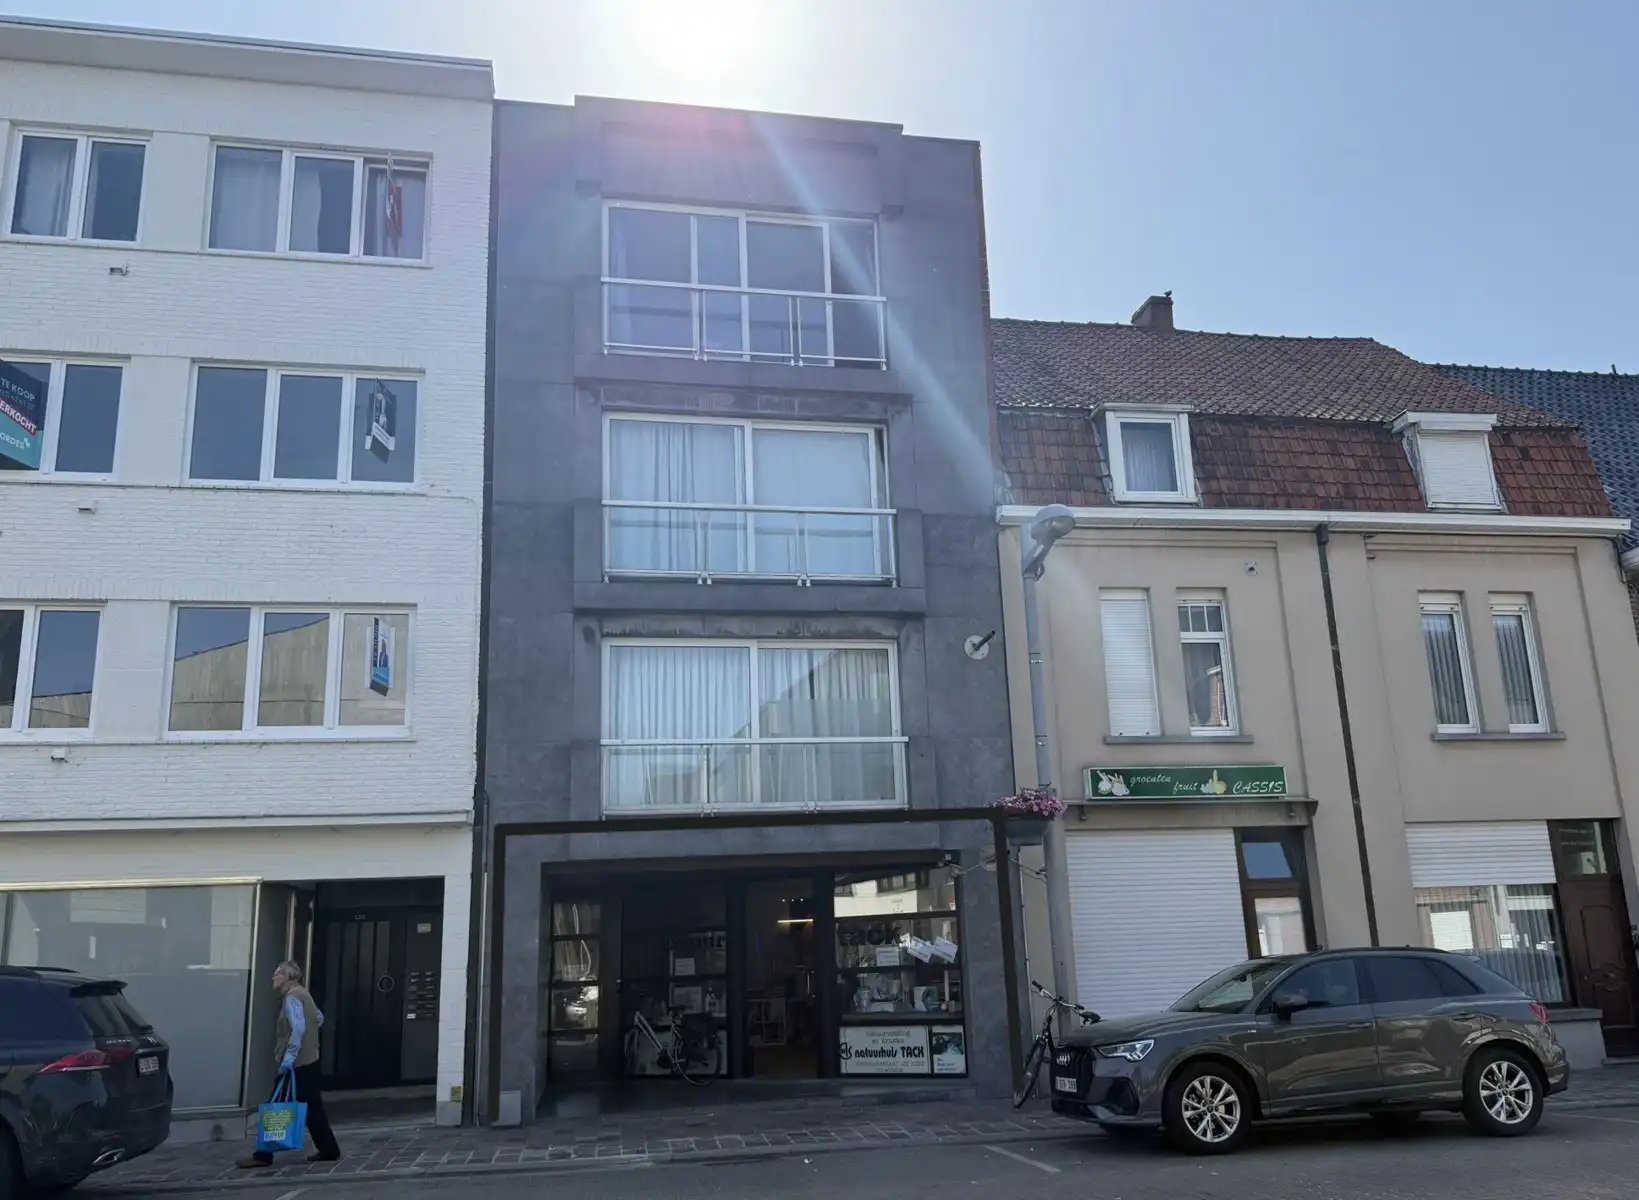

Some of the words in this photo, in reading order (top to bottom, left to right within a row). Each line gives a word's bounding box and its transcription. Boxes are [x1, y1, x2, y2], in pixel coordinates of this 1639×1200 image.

[1, 377, 10, 390] TE
[11, 383, 35, 401] KOOP
[0, 398, 37, 433] ERKOCHT
[1130, 773, 1172, 784] groenten
[1173, 781, 1198, 795] fruit
[1232, 780, 1284, 794] CASSIS
[855, 1046, 898, 1058] natuurhuis
[900, 1046, 925, 1058] TACK
